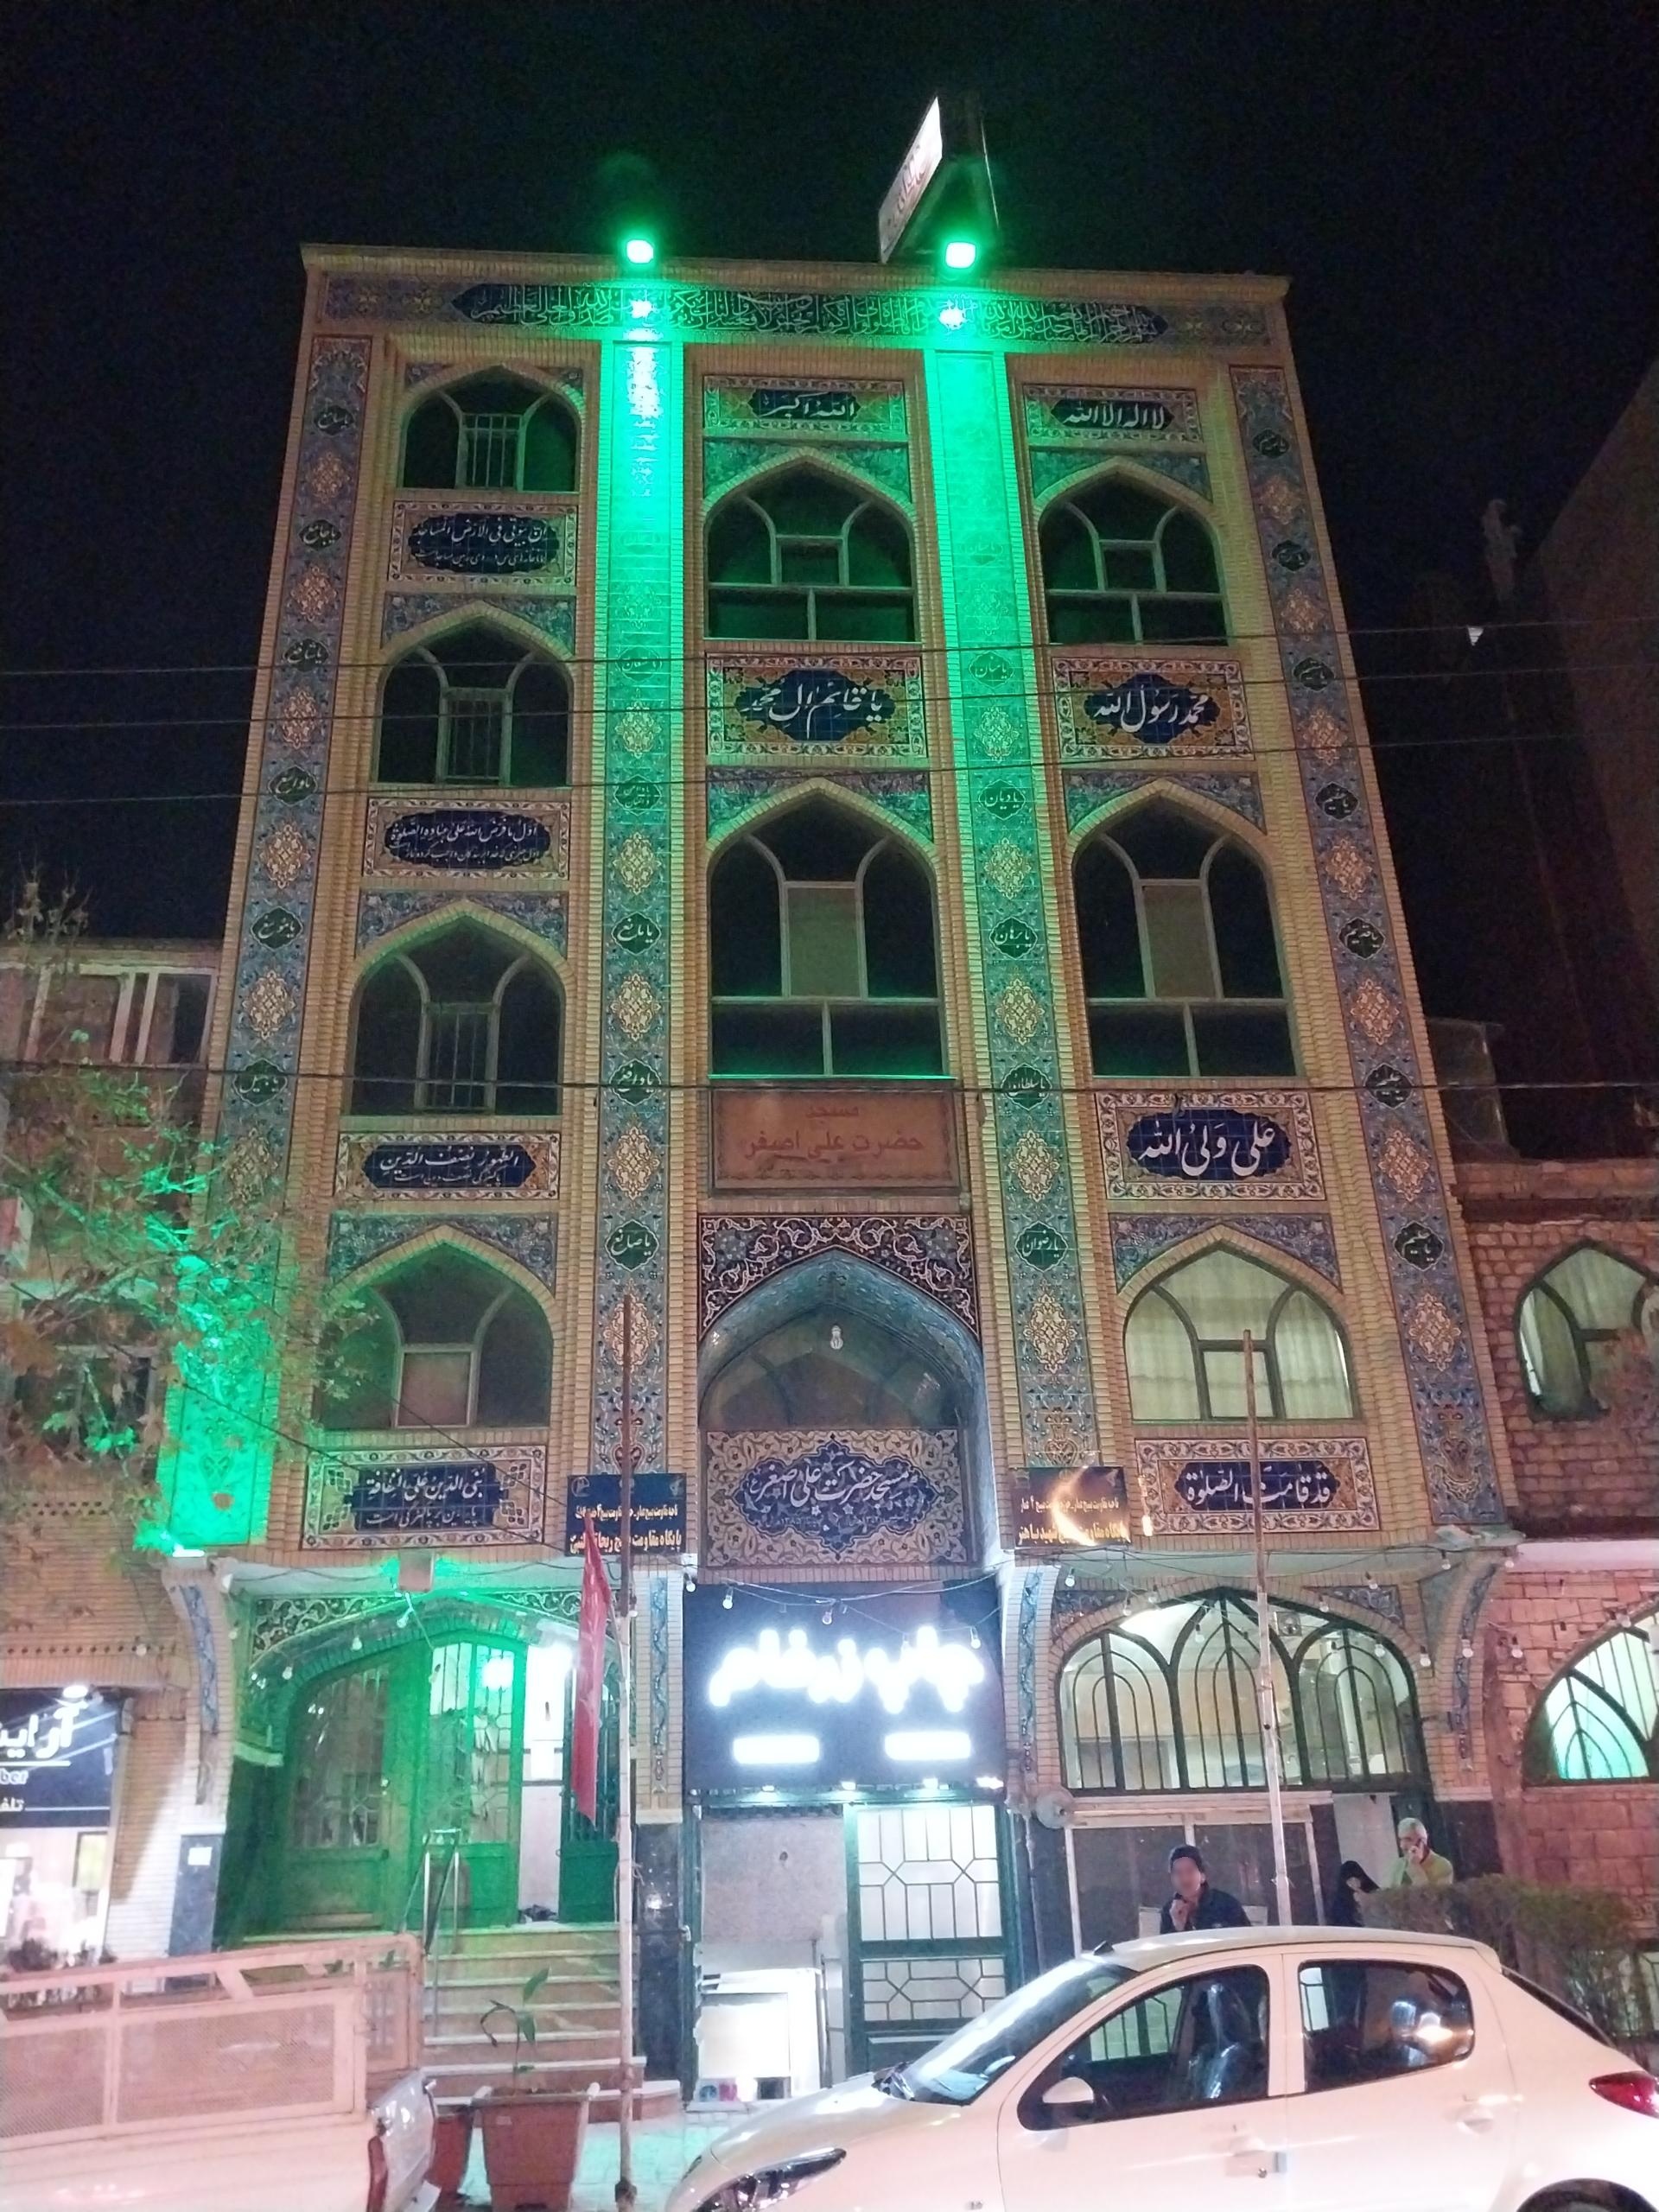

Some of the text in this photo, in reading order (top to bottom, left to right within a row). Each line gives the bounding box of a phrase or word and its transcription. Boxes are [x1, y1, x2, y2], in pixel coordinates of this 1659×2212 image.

[758, 391, 855, 419] الله اکبر
[1062, 400, 1099, 424] الله
[974, 655, 1001, 678] منان
[805, 681, 868, 741] قائم
[865, 690, 883, 723] یا
[1093, 684, 1209, 734] محمد رسول الله
[983, 788, 1012, 810] دیان
[616, 917, 645, 943] مانع
[994, 924, 1023, 949] برهان
[805, 1104, 860, 1124] مسجد
[805, 1130, 845, 1163] علی
[852, 1128, 925, 1159] حضرت
[1138, 1120, 1276, 1177] علی ولی الله
[610, 1229, 643, 1256] صانع
[1021, 1230, 1053, 1257] رضوان
[755, 1463, 798, 1502] اصغر
[790, 1458, 823, 1508] علی
[813, 1459, 884, 1505] حضرت
[862, 1470, 910, 1510] مسجد
[632, 1529, 660, 1552] مقاومت
[659, 1528, 683, 1554] پایگاه
[1018, 1522, 1040, 1546] باهنر
